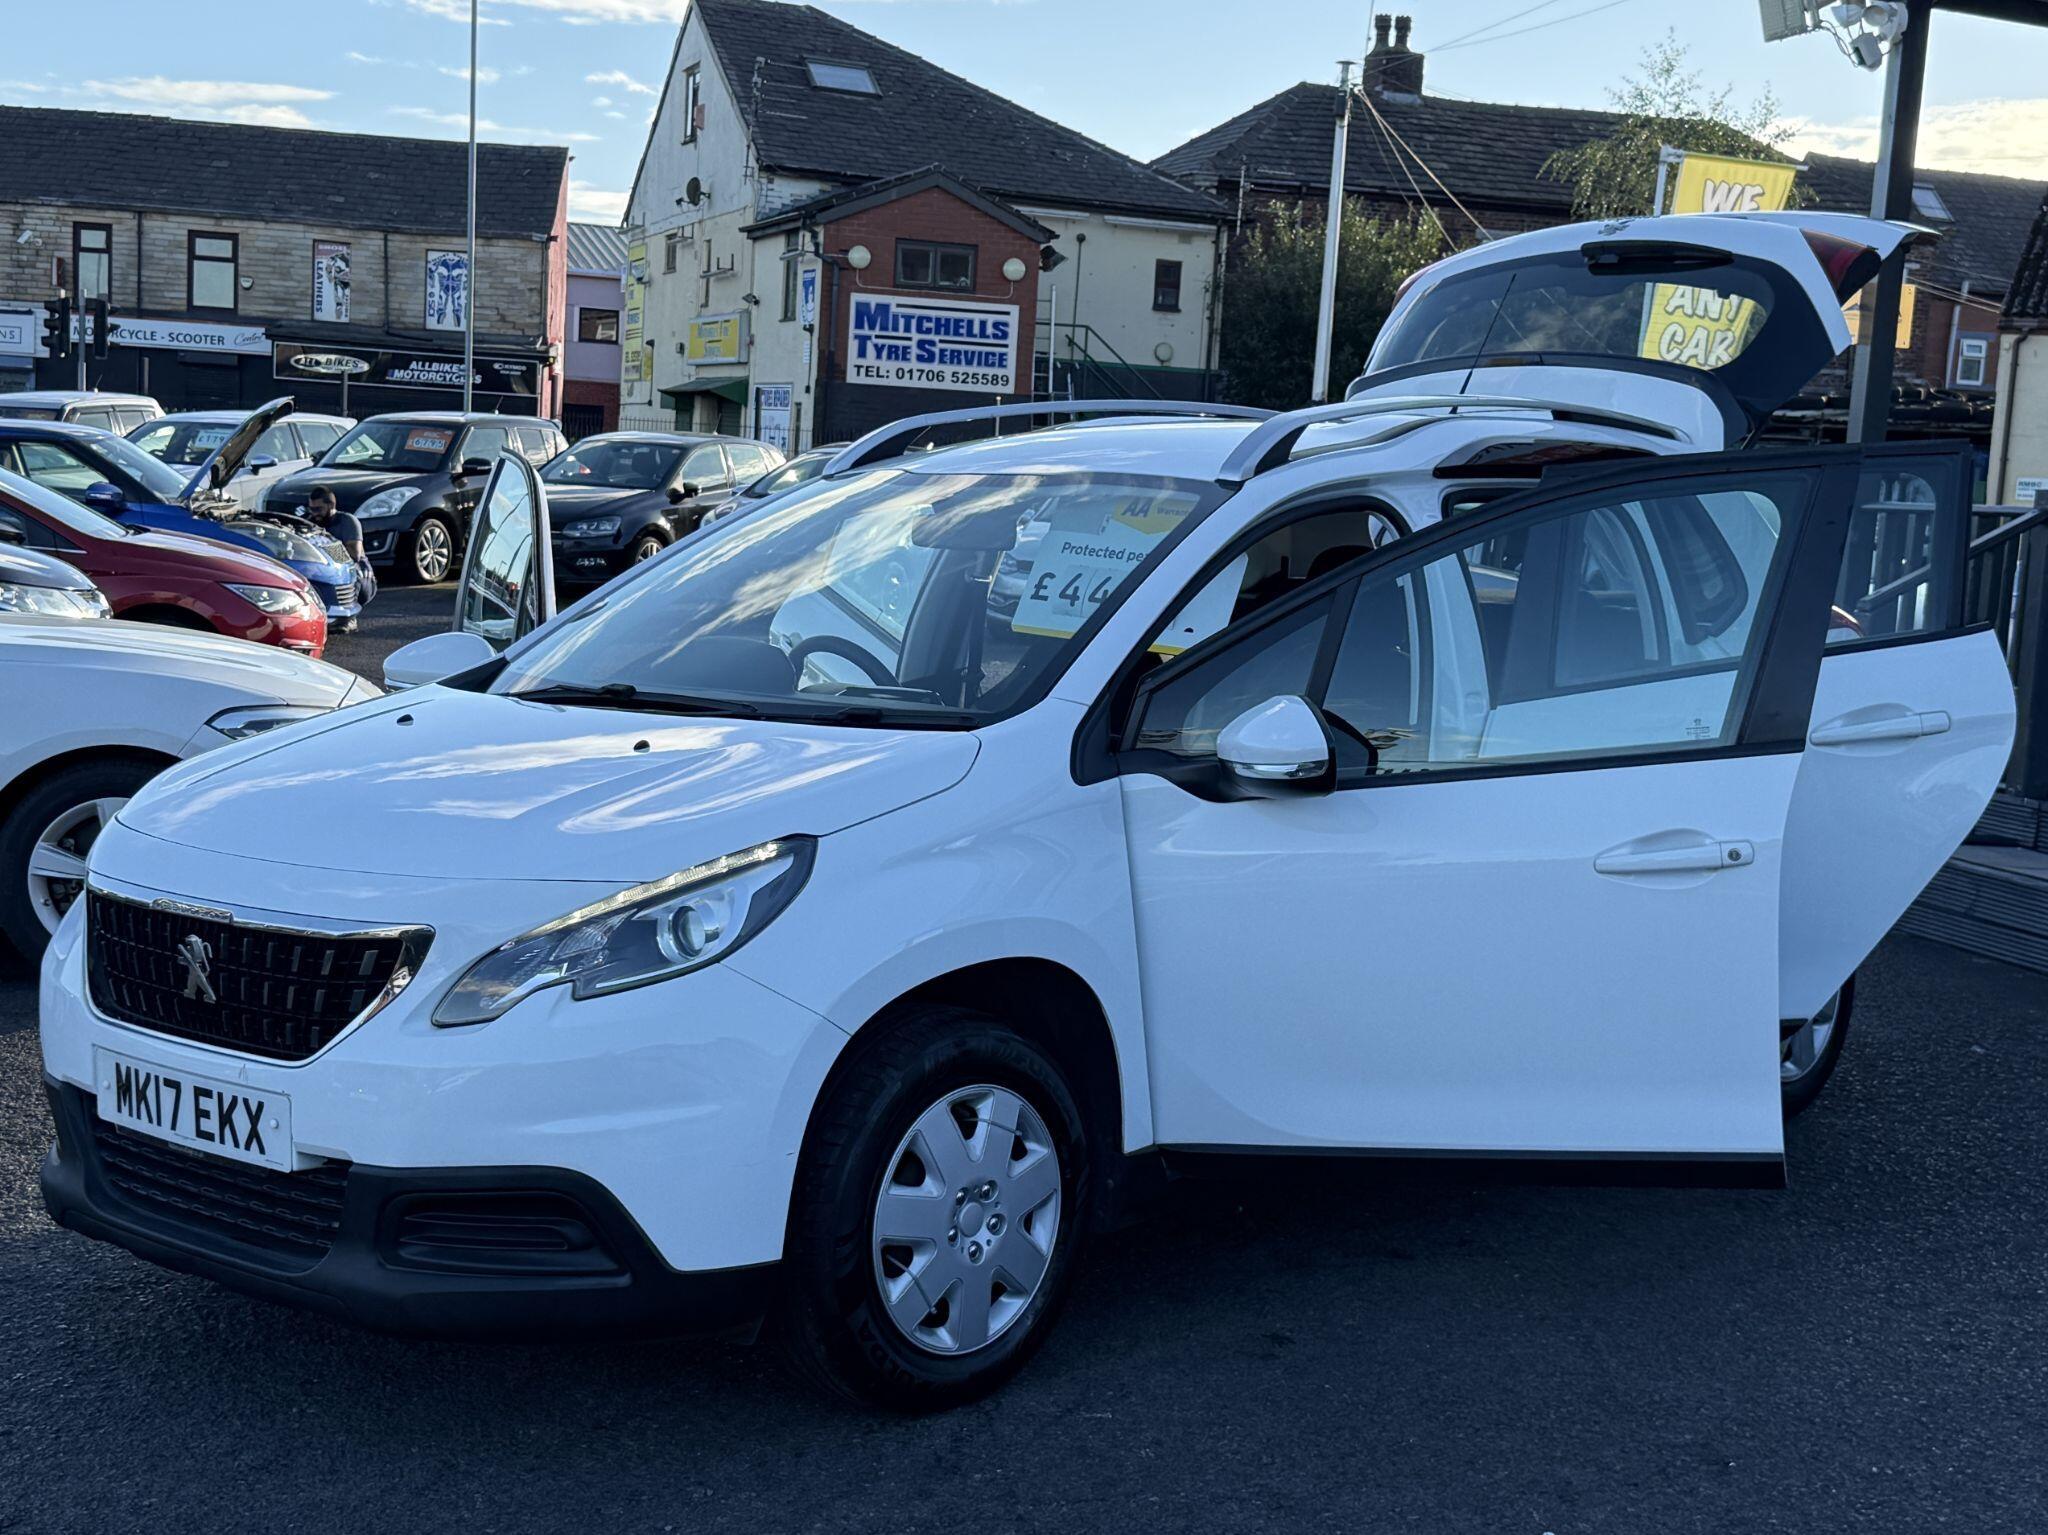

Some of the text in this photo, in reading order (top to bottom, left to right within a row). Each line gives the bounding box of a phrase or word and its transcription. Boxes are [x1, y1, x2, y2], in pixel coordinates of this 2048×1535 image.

[1702, 178, 1765, 212] WE
[854, 301, 1010, 341] MITCHELLS
[168, 332, 225, 346] SCOOTER
[853, 334, 1009, 369] TYRE SERVICE
[1658, 322, 1736, 367] CAR
[325, 358, 360, 368] BIKES
[854, 364, 1010, 387] TEL: 01706 525589
[1122, 499, 1150, 518] AA
[1061, 541, 1148, 563] Protected pe
[115, 1062, 266, 1155] MK17 EKX
